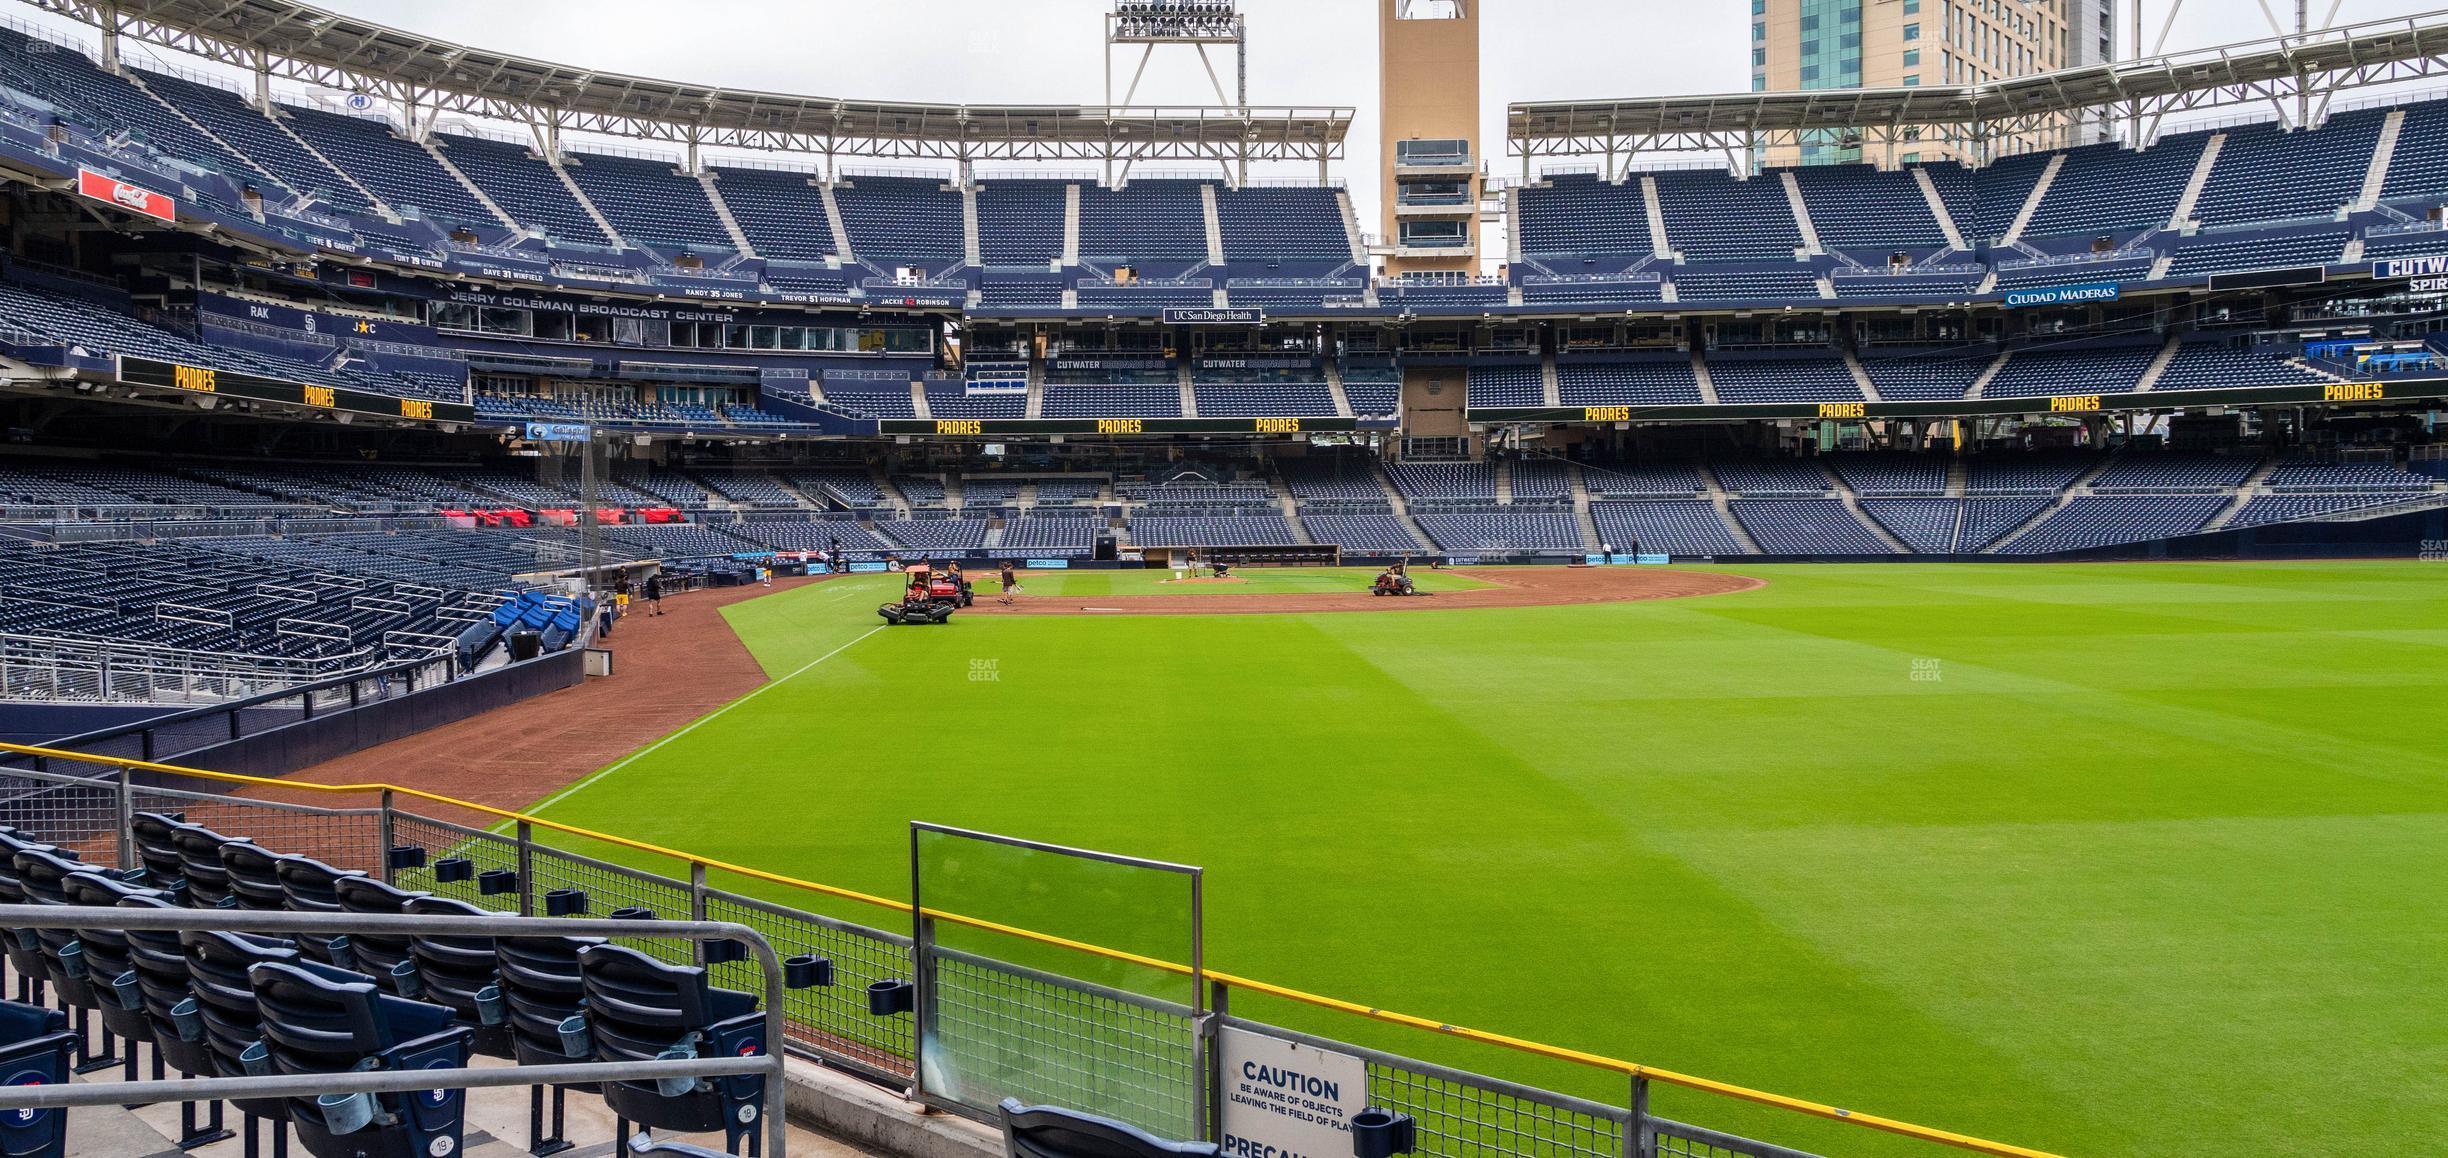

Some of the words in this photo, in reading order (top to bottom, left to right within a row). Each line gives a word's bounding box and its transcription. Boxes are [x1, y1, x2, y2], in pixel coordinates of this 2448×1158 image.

[305, 235, 324, 245] STEVE
[334, 241, 356, 253] GARVEY
[393, 253, 410, 263] TONY
[421, 259, 443, 268] GWYNN
[2388, 257, 2448, 276] CUTW
[483, 268, 501, 277] DAVE
[502, 270, 512, 279] 31
[513, 272, 543, 282] WINFIELD
[710, 290, 720, 298] 35
[722, 291, 743, 299] JONES
[820, 296, 851, 304] HOFFMAN
[2008, 292, 2056, 305] CIUDAD
[2060, 287, 2116, 300] MADERAS
[250, 306, 269, 319] RAK
[450, 291, 496, 304] JERRY
[503, 297, 573, 312] COLEMAN
[579, 304, 670, 319] BROADCAST
[676, 311, 733, 322] CENTER
[1174, 310, 1187, 320] UC
[1188, 310, 1203, 320] San
[1203, 311, 1226, 322] Diego
[1226, 310, 1252, 320] Health
[1057, 360, 1100, 369] CUTWATER
[1203, 360, 1246, 368] CUTWATER
[175, 365, 215, 392] PADRES
[304, 384, 335, 408] PADRES
[2324, 383, 2383, 401] PADRES
[401, 399, 432, 419] PADRES
[1819, 404, 1864, 417] PADRES
[2050, 395, 2100, 412] PADRES
[1585, 407, 1629, 421] PADRES
[937, 420, 981, 434] PADRES
[1098, 420, 1142, 433] PADRES
[1256, 418, 1299, 432] PADRES
[850, 562, 868, 571] petco
[1243, 1061, 1339, 1102] CAUTION
[1240, 1083, 1252, 1094] BE
[1253, 1087, 1286, 1103] AWARE
[1287, 1094, 1300, 1106] OF
[1302, 1099, 1343, 1118] OBJECTS
[743, 1108, 751, 1118] 18
[1230, 1092, 1267, 1110] LEAVING
[1269, 1102, 1287, 1115] THE
[1288, 1109, 1314, 1122] FIELD
[1316, 1115, 1329, 1126] OF
[1331, 1119, 1353, 1133] PLAY
[436, 1140, 447, 1152] 19
